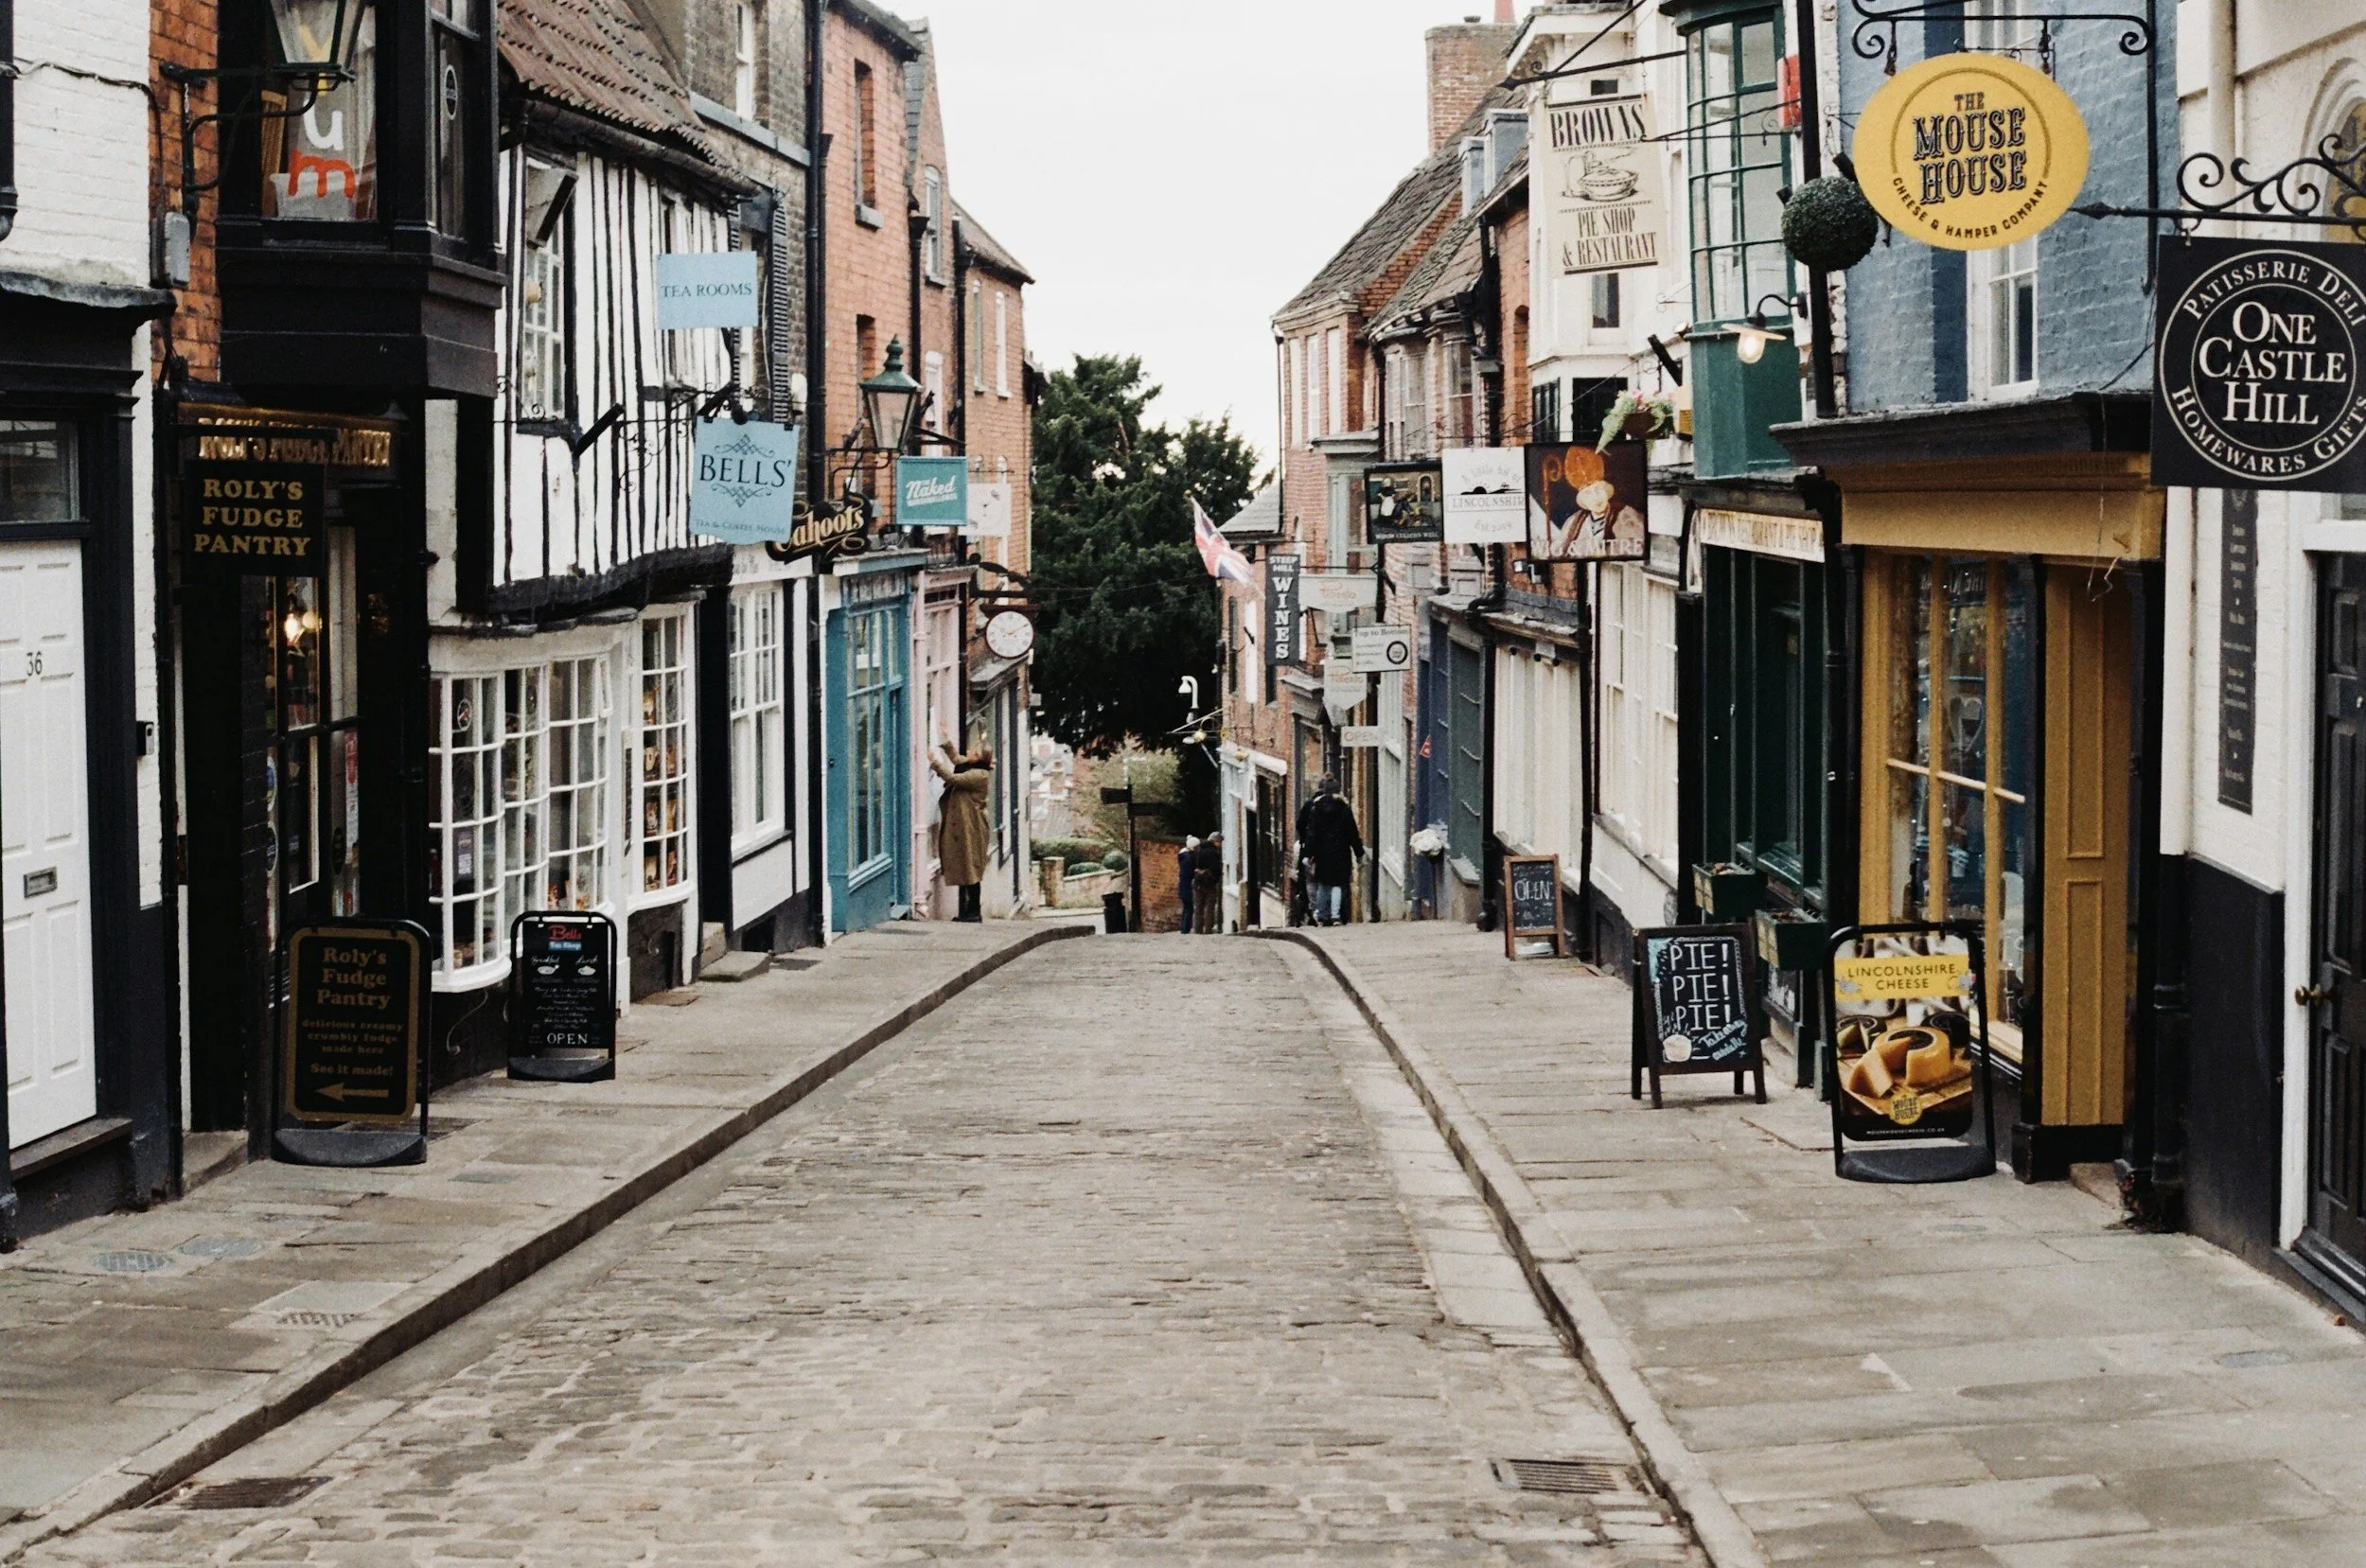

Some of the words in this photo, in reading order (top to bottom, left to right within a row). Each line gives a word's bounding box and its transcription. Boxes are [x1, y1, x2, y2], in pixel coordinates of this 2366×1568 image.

[1954, 92, 1985, 112] THE
[1549, 104, 1646, 149] BROWNS
[1913, 106, 2026, 161] MOUSE
[1919, 150, 2027, 205] HOUSE
[1893, 177, 1928, 222] CHEESE
[1931, 220, 1940, 230] &
[1946, 224, 1999, 238] HAMPER
[2002, 181, 2048, 230] COMPANY
[1578, 210, 1599, 238] PIE
[1602, 207, 1636, 235] SHOP
[1563, 243, 1573, 267] &
[1577, 232, 1657, 265] RESTAURANT
[662, 284, 692, 298] TEA
[696, 282, 752, 297] ROOMS
[2182, 260, 2311, 320] PATISSERIE
[2317, 271, 2366, 327] DELI
[2232, 301, 2318, 345] ONE
[2198, 336, 2347, 383] CASTLE
[2221, 380, 2320, 425] HILL
[2171, 386, 2306, 474] HOMEWARES
[2313, 395, 2366, 460] GIFTS
[699, 453, 792, 489] BELLS'
[203, 479, 304, 501] ROLY'S
[905, 475, 957, 500] Naked
[1452, 495, 1526, 508] LINCOLNSHIR
[202, 505, 304, 528] FUDGE
[193, 533, 311, 556] PANTRY
[1587, 537, 1645, 555] MITRE
[1272, 575, 1294, 661] WINES
[26, 651, 44, 677] 36
[322, 946, 387, 966] Roly's
[1669, 943, 1729, 971] PIE!
[321, 968, 387, 989] Fudge
[1847, 962, 1956, 978] LINCOLNSHIRE
[1672, 972, 1730, 1003] PIE!
[1876, 978, 1930, 991] CHEESE
[316, 988, 391, 1010] Pantry
[1675, 1003, 1731, 1031] PIE!
[546, 1031, 589, 1046] OPEN
[310, 1063, 333, 1074] See
[338, 1063, 349, 1075] it
[352, 1064, 394, 1077] made!
